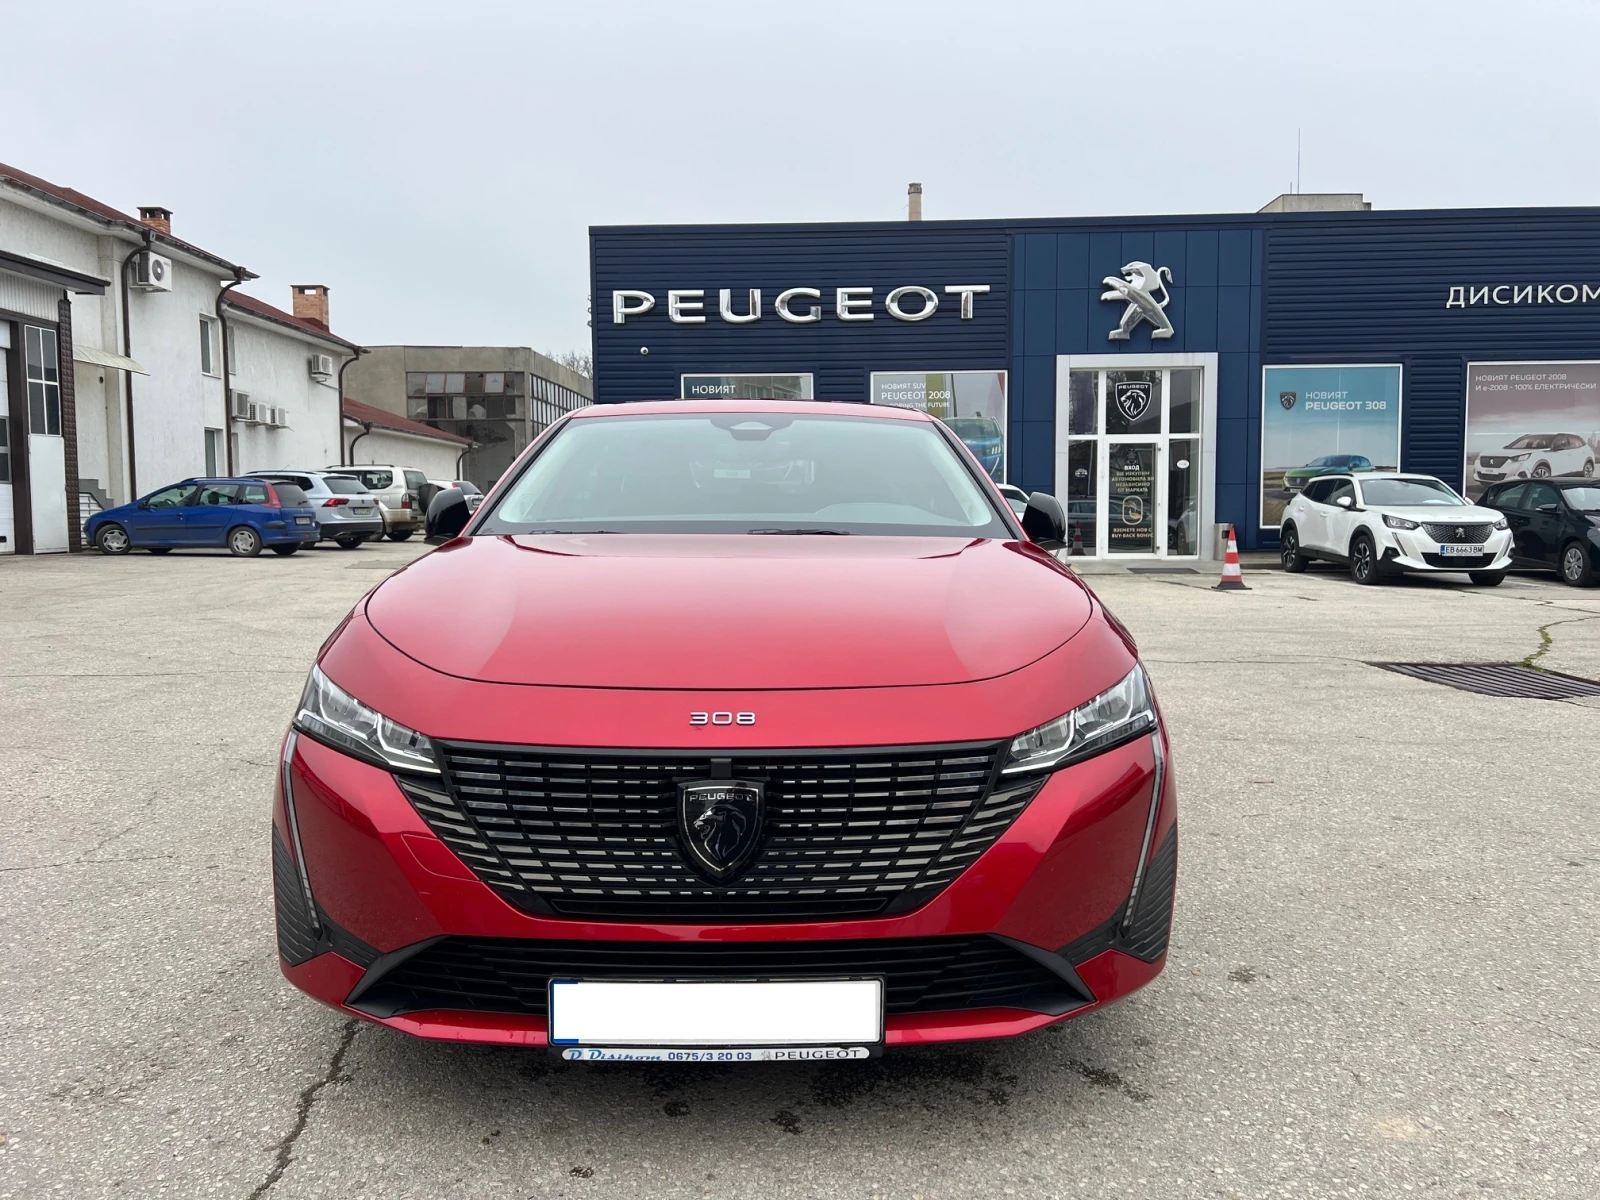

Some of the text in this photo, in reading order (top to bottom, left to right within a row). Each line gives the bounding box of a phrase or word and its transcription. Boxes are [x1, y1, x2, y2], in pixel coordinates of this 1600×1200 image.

[1446, 284, 1600, 308] ДИСИКОМ
[612, 285, 990, 324] PEUGEOT
[1475, 373, 1568, 382] НОВИЯТ PEUGEOT 2008
[691, 385, 736, 394] НОВИЯТ
[1515, 383, 1534, 391] 100%
[1534, 382, 1597, 390] ЕЛЕКТРИЧЕСКИ
[881, 390, 951, 400] PEUGEOT 2008
[1305, 391, 1349, 400] НОВИЯТ
[1305, 401, 1387, 410] PEUGEOT 308
[689, 711, 756, 725] 308
[689, 792, 754, 802] PEUGEOT
[668, 1052, 714, 1062] 0675/3
[717, 1052, 733, 1061] 20
[736, 1052, 752, 1061] 03
[775, 1050, 861, 1061] PEUGEOT
